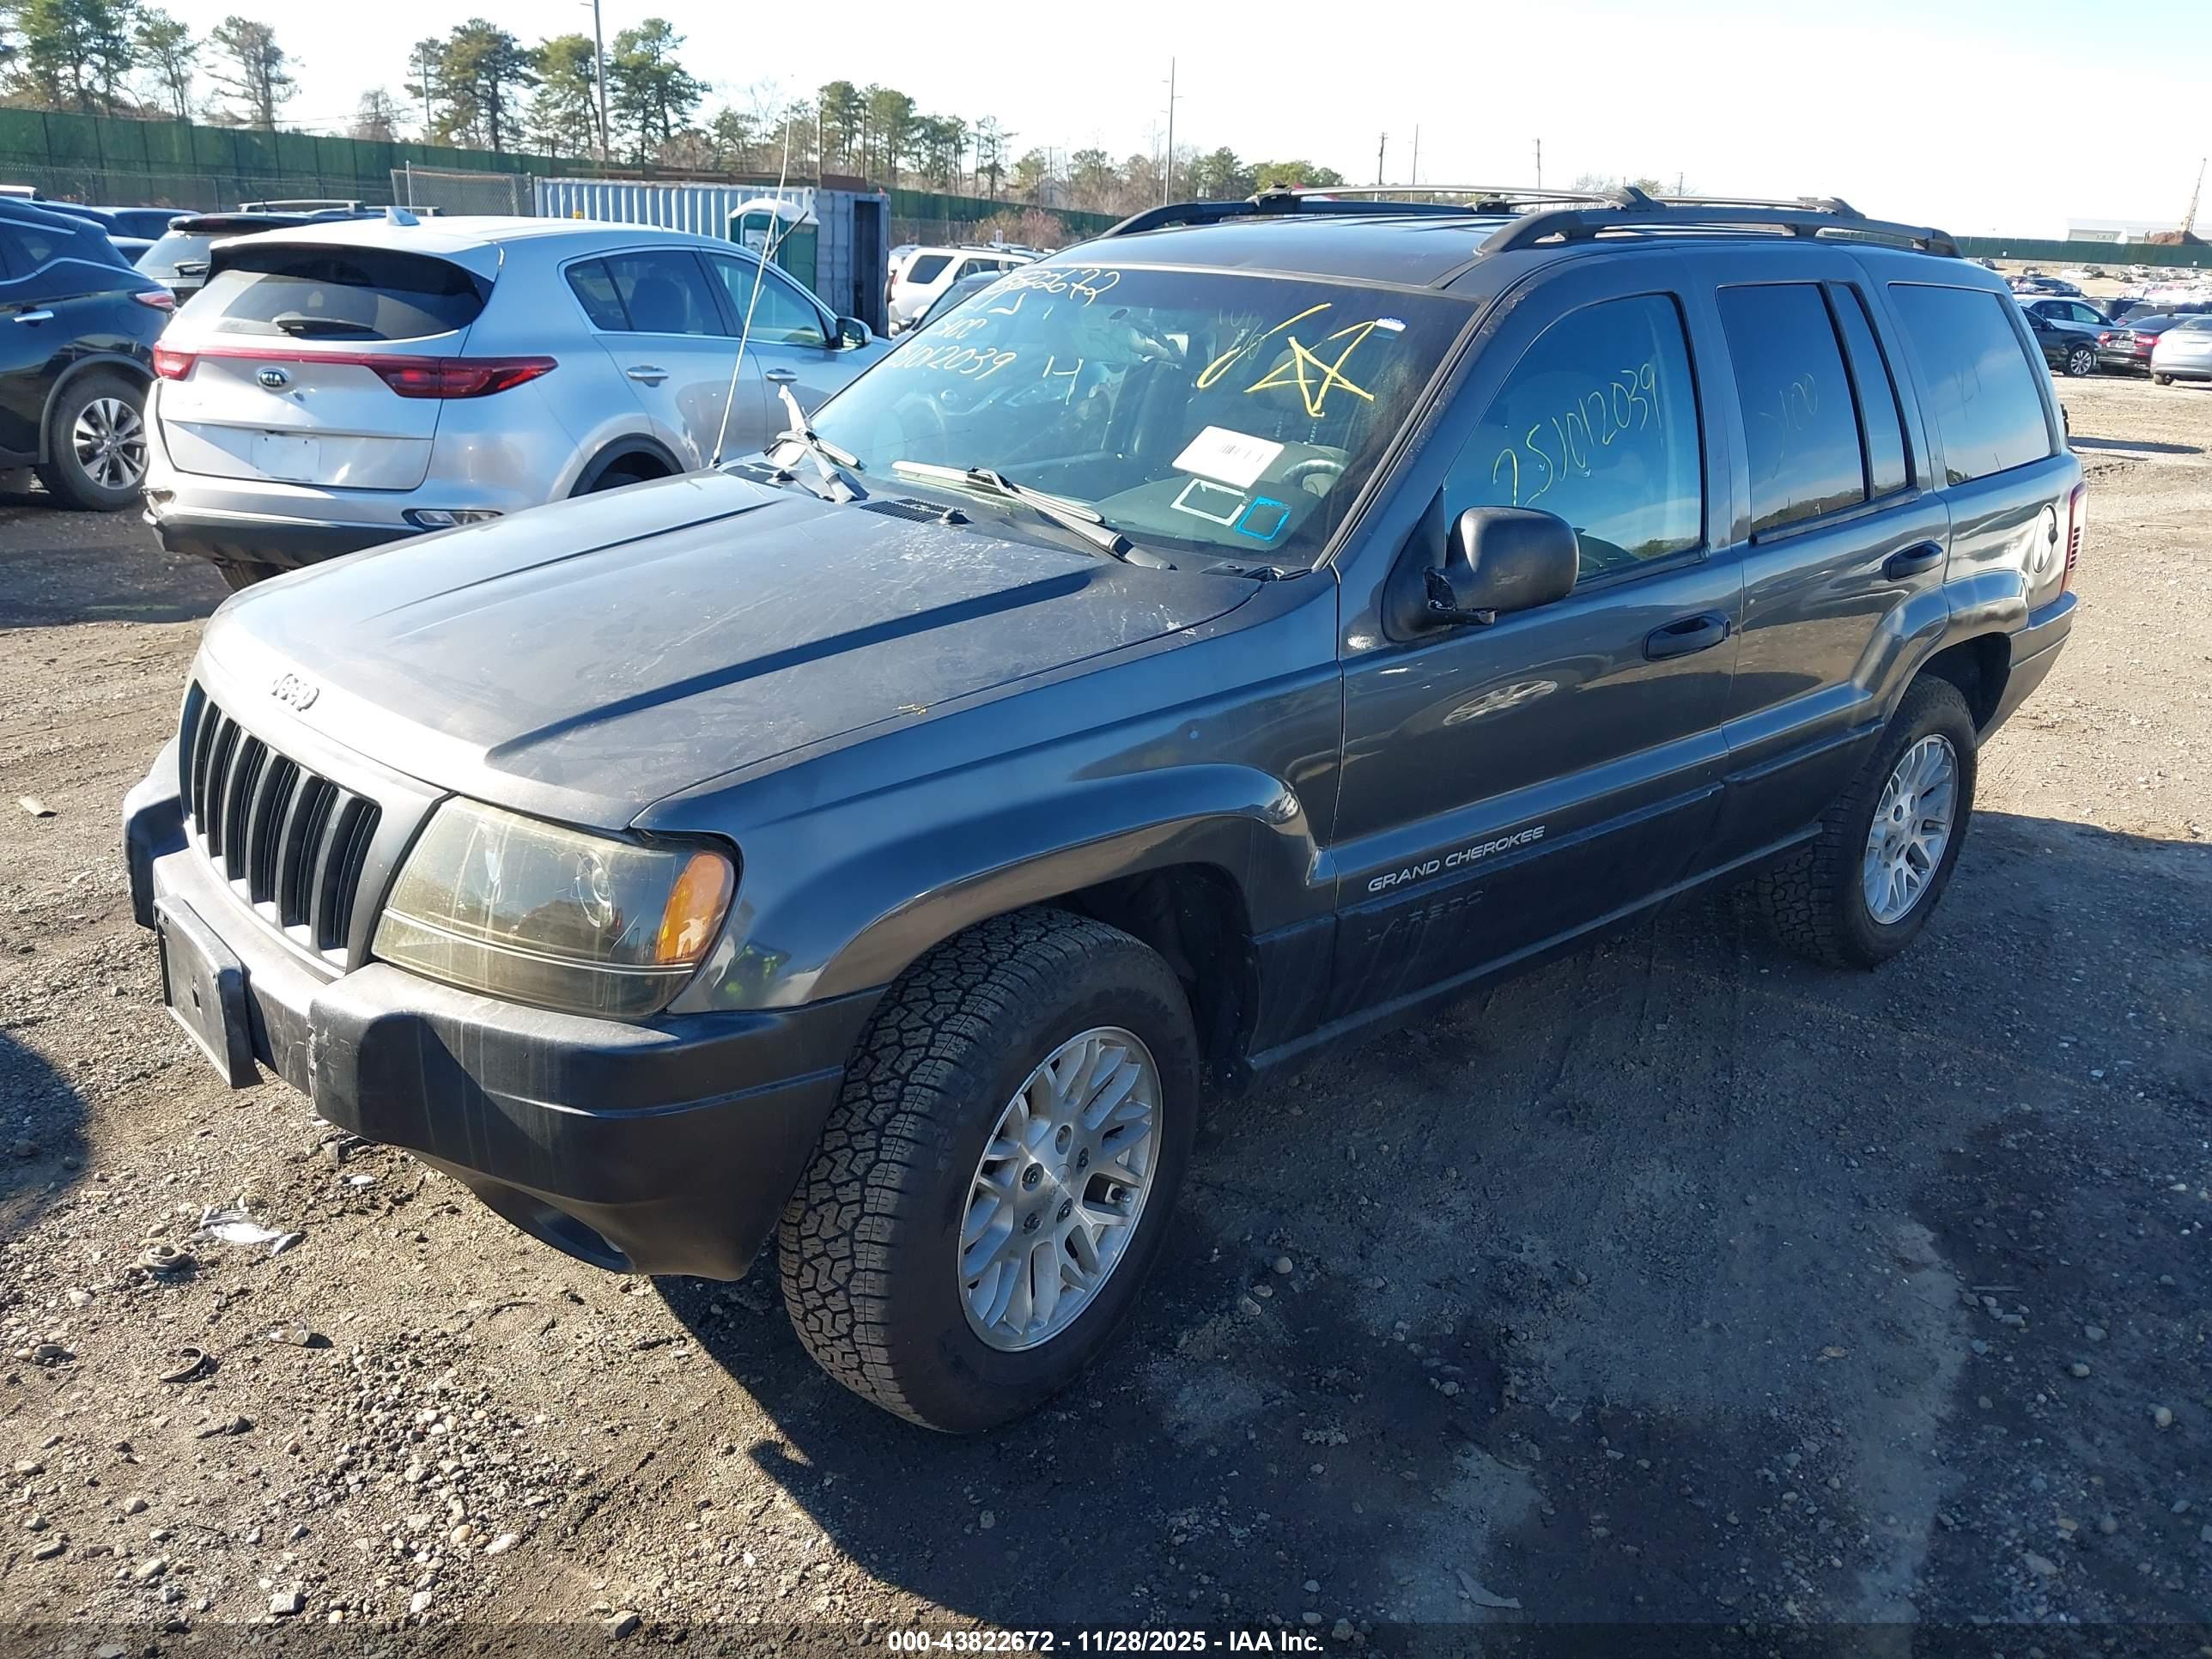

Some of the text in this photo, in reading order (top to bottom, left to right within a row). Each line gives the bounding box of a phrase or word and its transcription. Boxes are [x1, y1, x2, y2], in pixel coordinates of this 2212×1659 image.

[261, 373, 283, 386] KIA
[270, 672, 320, 712] Jeep
[1368, 825, 1546, 892] GRAND CHEROKEE
